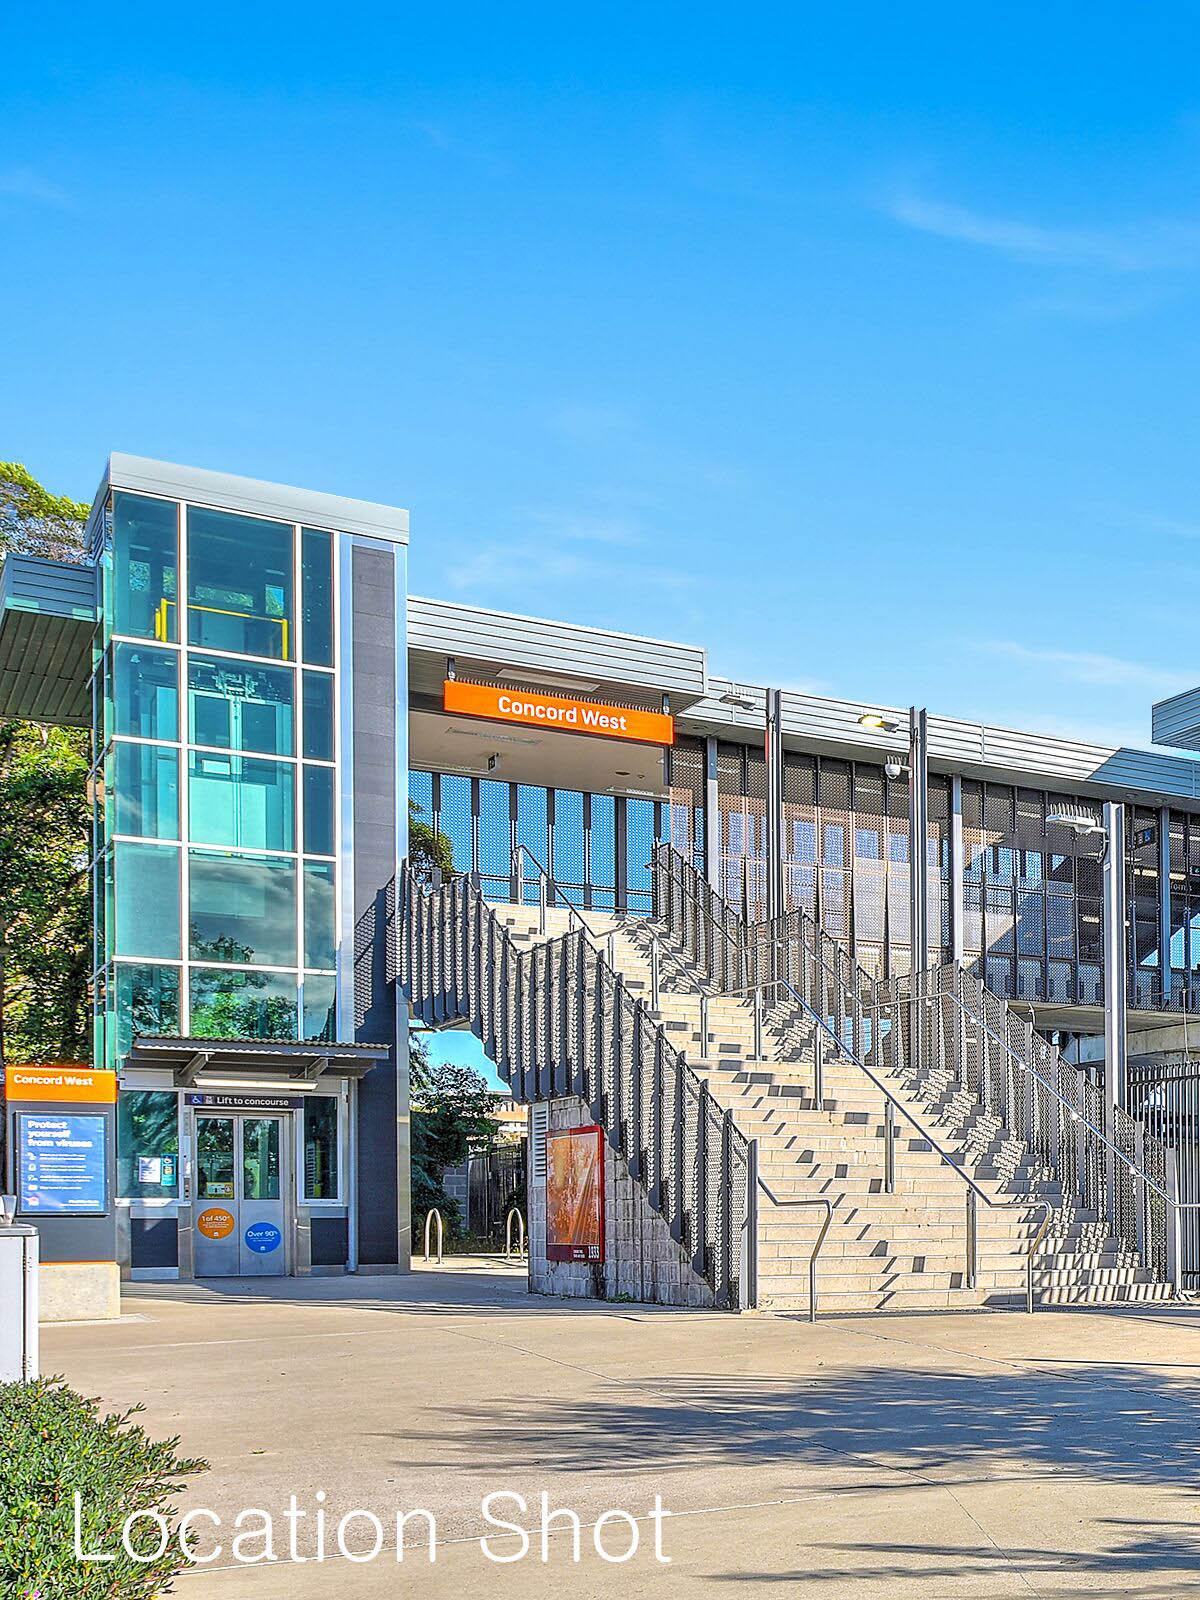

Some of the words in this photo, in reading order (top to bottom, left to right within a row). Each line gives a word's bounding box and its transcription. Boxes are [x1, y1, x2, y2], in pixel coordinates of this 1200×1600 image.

[498, 696, 577, 723] Concord
[581, 710, 627, 731] West
[13, 1074, 63, 1085] Concord
[64, 1076, 94, 1086] West
[216, 1096, 232, 1104] Lift
[234, 1097, 243, 1105] to
[27, 1120, 68, 1129] Protect
[27, 1130, 72, 1139] yourself
[27, 1139, 54, 1147] from
[55, 1139, 93, 1148] viruses
